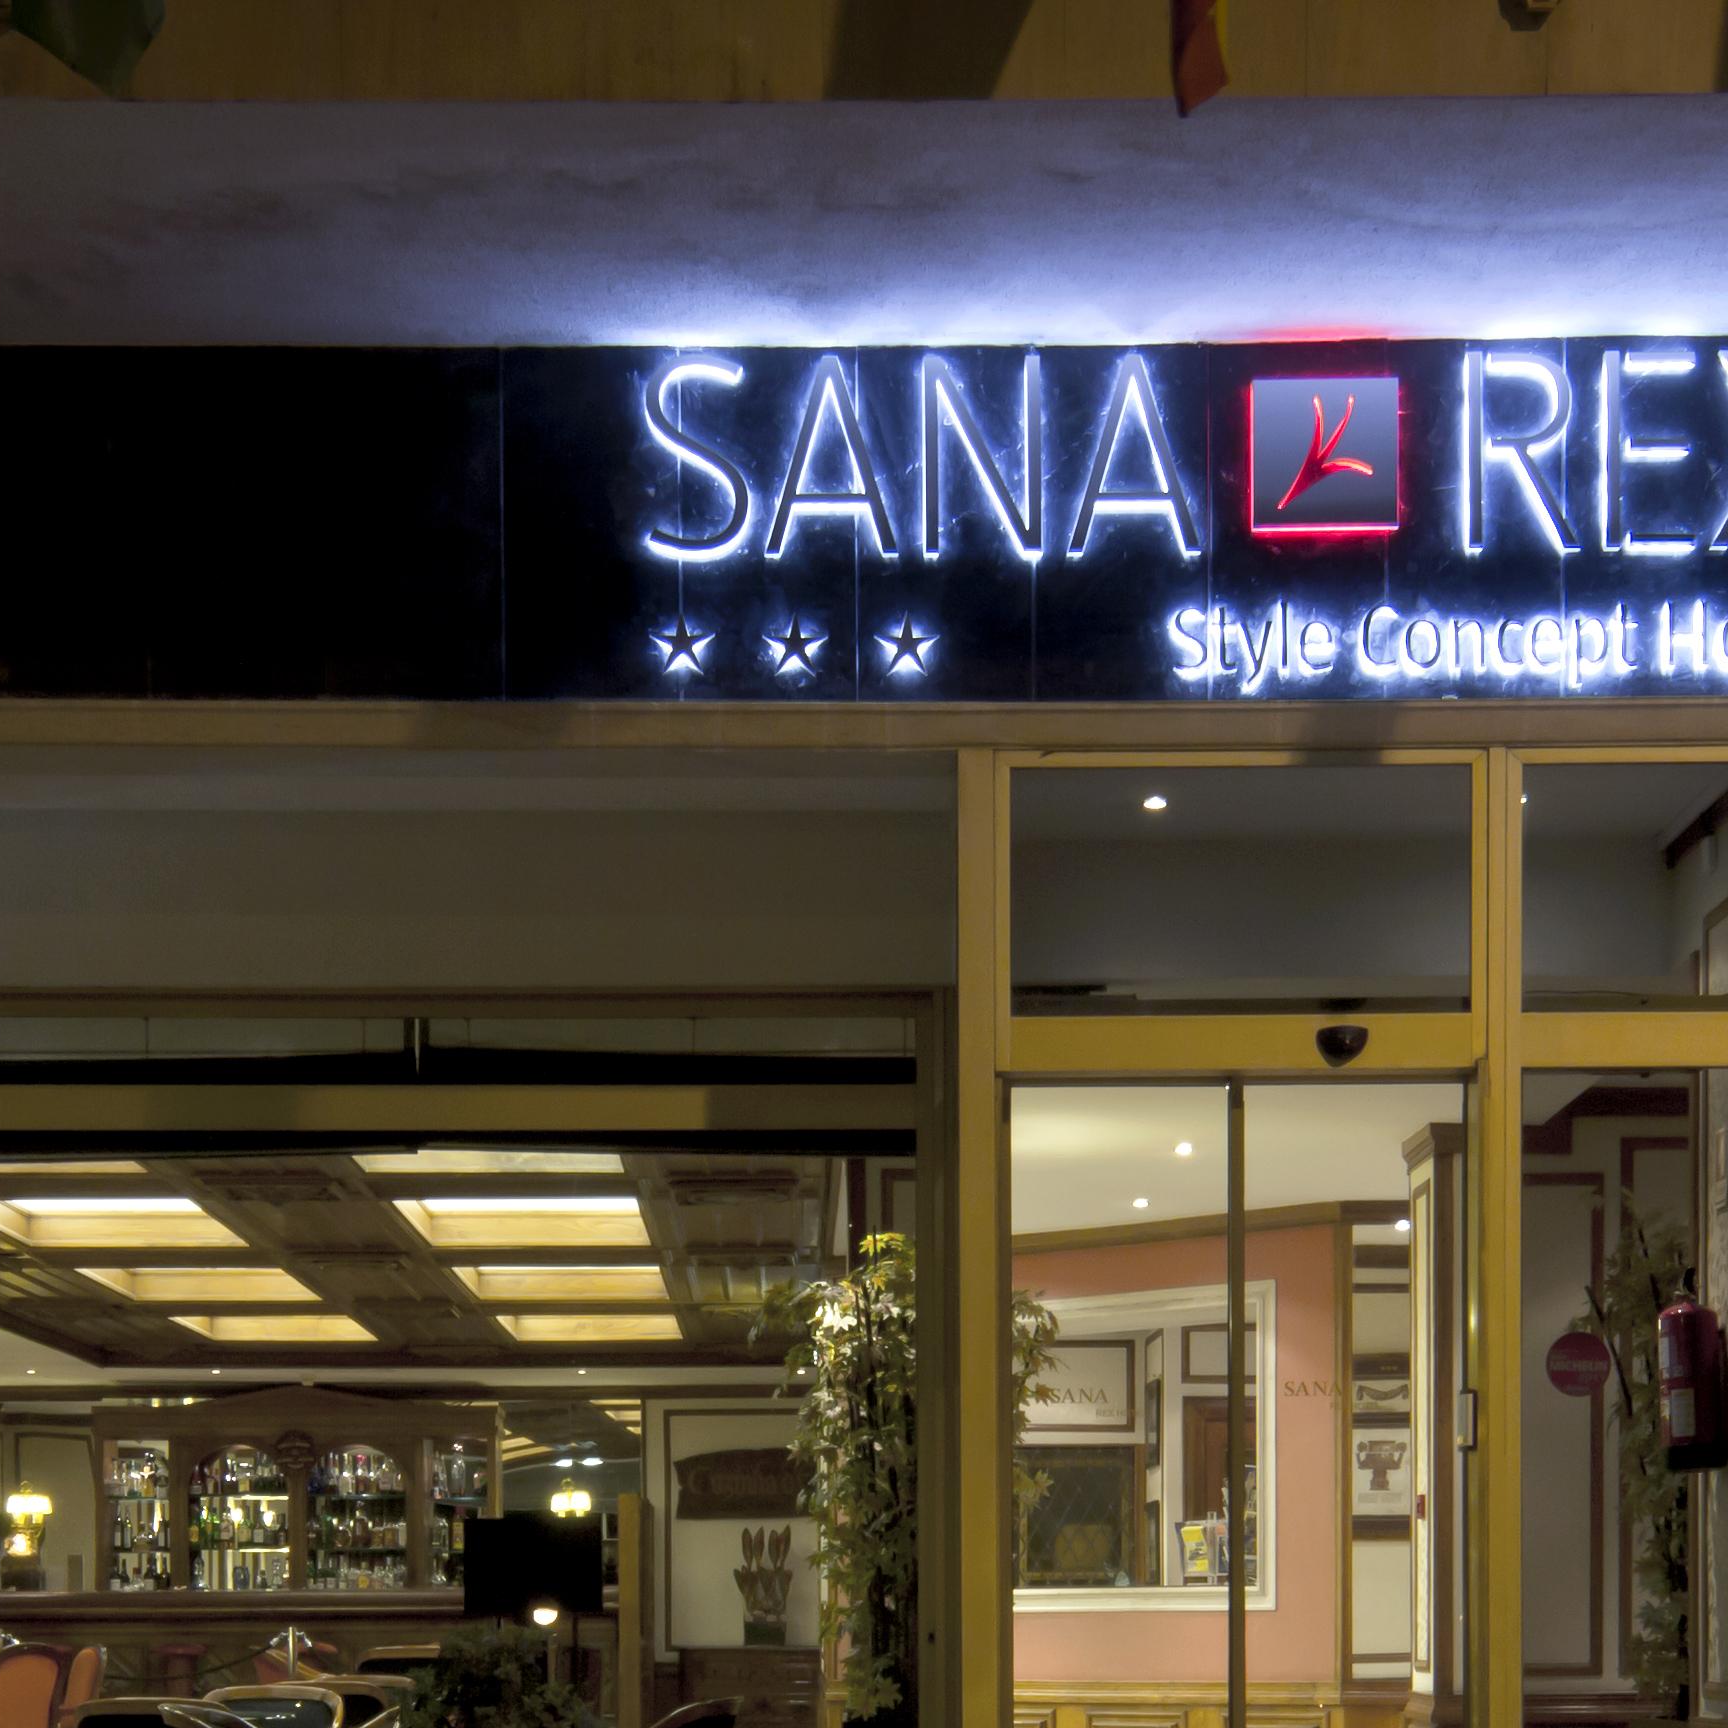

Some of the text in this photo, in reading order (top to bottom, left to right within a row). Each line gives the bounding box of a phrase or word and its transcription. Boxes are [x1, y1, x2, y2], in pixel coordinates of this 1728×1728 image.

[642, 350, 1204, 562] SANA
[1168, 596, 1336, 696] Style
[1356, 598, 1639, 692] Concept
[1050, 1387, 1109, 1404] SANA
[1283, 1380, 1343, 1397] SANA
